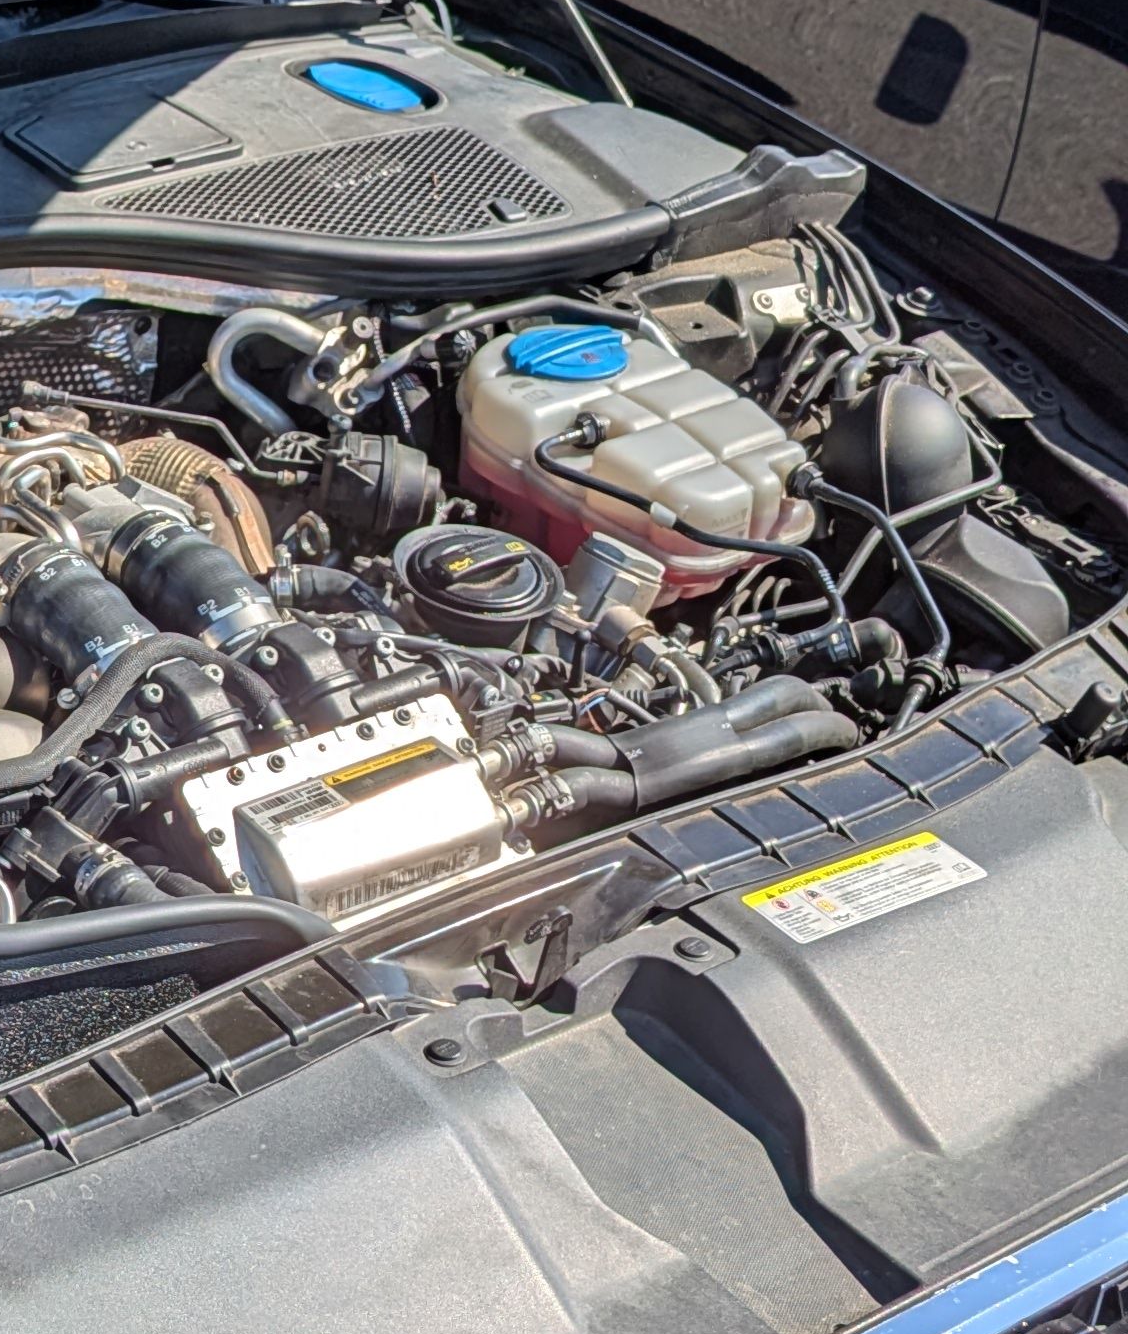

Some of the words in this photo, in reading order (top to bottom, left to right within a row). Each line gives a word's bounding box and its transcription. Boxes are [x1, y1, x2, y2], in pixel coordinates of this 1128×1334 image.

[151, 533, 168, 548] B2
[71, 558, 88, 567] B1
[39, 567, 57, 581] B2
[234, 587, 250, 597] B1
[197, 599, 218, 616] B2
[122, 623, 138, 634] B1
[84, 636, 104, 653] B2
[778, 875, 821, 895] ACHTUNG
[823, 859, 868, 877] WARNING
[871, 842, 918, 861] ATTENTION
